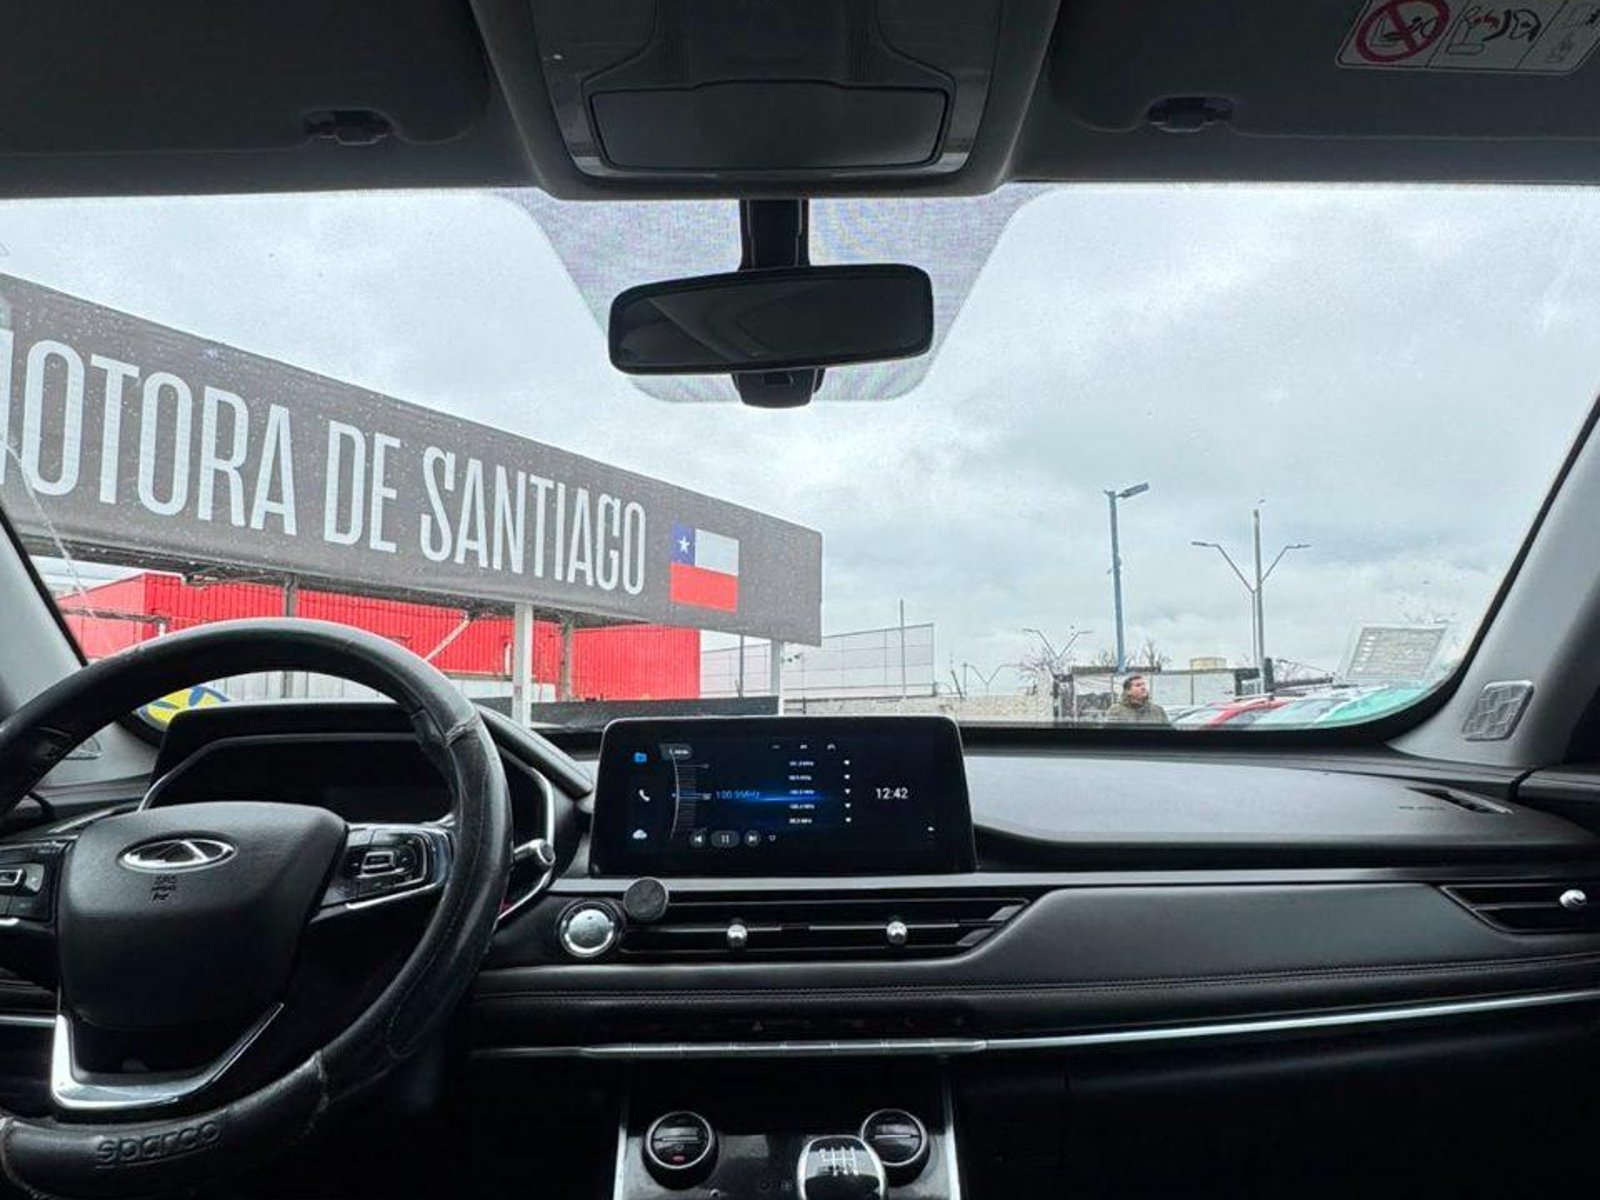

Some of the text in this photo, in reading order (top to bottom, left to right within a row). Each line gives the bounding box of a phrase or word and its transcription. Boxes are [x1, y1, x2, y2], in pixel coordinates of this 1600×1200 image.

[0, 328, 646, 595] OTORA DE SANTIAGO
[876, 787, 908, 800] 12:42
[95, 1120, 220, 1168] sparco
